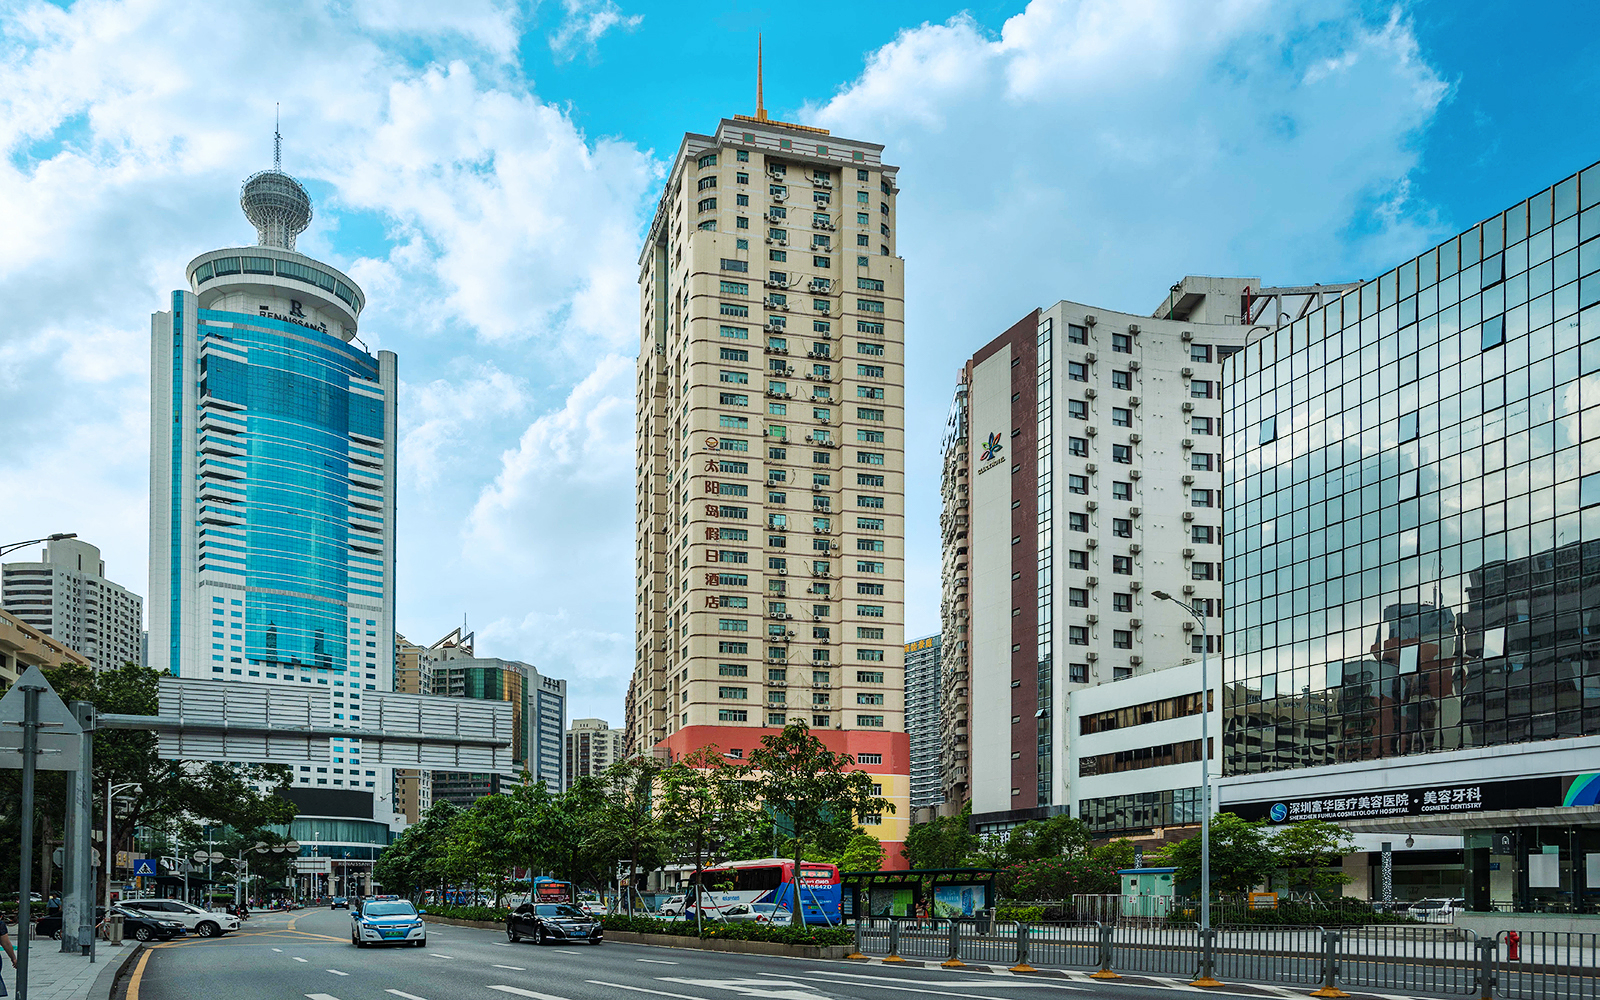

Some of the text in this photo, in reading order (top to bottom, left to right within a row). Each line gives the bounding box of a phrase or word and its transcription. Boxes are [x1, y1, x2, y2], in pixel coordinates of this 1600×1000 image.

[259, 311, 328, 334] RENAISSANCE
[704, 459, 719, 609] 太阳岛假日酒店
[1289, 793, 1409, 814] 深圳富华医疗美容医院
[1423, 786, 1482, 805] 美容牙科
[1421, 802, 1482, 812] COSMETIC DENTISTRY
[1317, 812, 1337, 820] FUHUA
[1337, 809, 1378, 818] COSMETOLOGY
[1379, 807, 1409, 816] HOSPITAL
